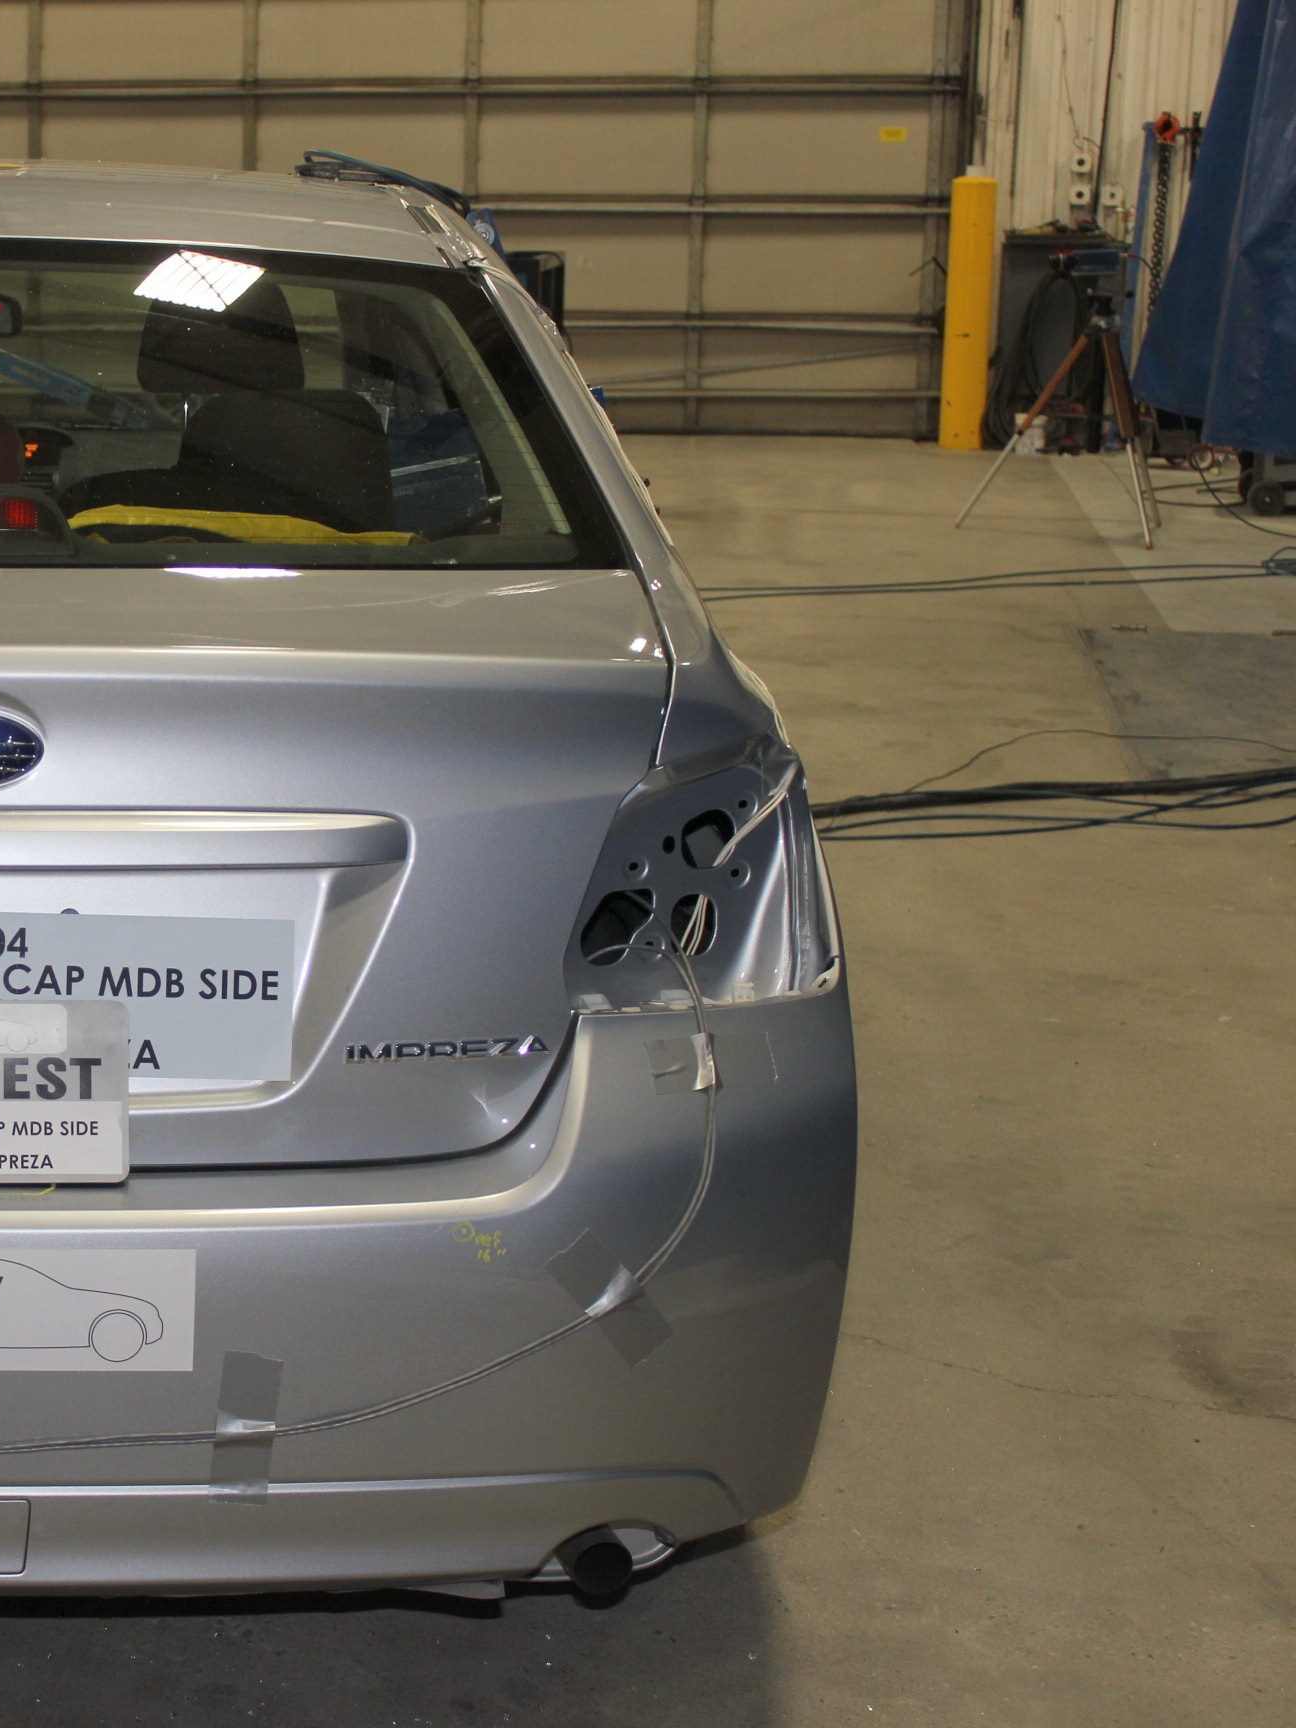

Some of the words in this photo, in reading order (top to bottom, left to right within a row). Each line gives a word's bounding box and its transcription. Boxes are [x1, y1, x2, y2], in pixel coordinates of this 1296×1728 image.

[98, 966, 185, 999] MDB
[198, 968, 279, 1001] SIDE
[344, 1035, 551, 1064] IMPREZA
[11, 1121, 54, 1136] MDB
[59, 1121, 99, 1136] SIDE
